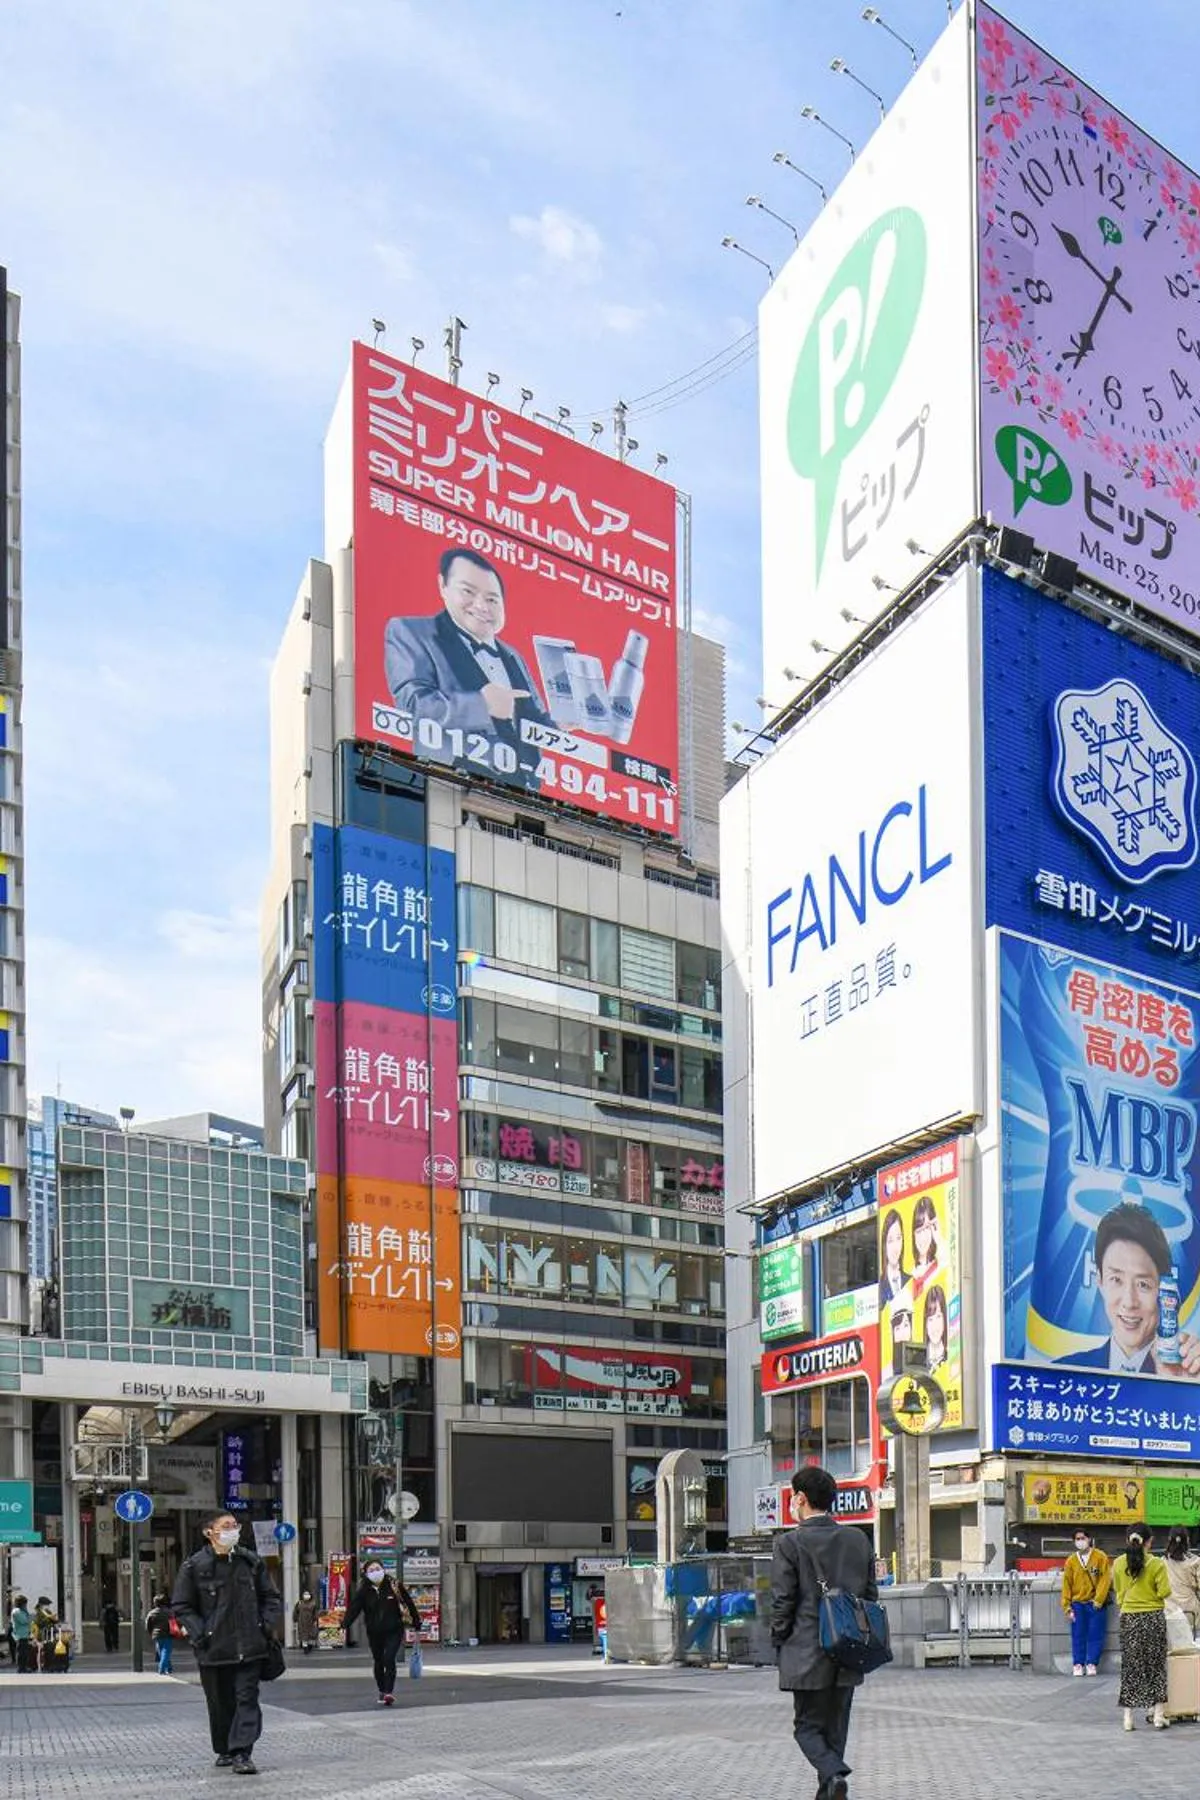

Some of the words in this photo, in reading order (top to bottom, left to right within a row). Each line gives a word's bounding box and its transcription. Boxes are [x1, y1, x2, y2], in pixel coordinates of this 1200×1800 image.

[1019, 158, 1054, 207] 10
[1055, 148, 1084, 187] 11
[1094, 164, 1125, 211] 12
[1011, 210, 1039, 246] 9
[1024, 277, 1053, 304] 8
[368, 358, 543, 456] スーパー
[1103, 375, 1122, 410] 6
[1142, 386, 1163, 422] 5
[1170, 368, 1193, 401] 4
[368, 401, 669, 552] ミリオンヘアー
[842, 403, 931, 562] ピップ
[368, 452, 475, 510] SUPER
[486, 505, 593, 566] MILLION
[602, 550, 670, 592] HAIR
[1084, 471, 1177, 560] ピップ
[1079, 532, 1129, 579] Mar.
[527, 726, 579, 752] ルアン
[342, 871, 432, 924] 龍角散
[767, 783, 953, 988] FANCL
[800, 942, 912, 1040] 正直品質。
[1068, 969, 1194, 1048] 骨密度を
[344, 1046, 435, 1095] 龍角散
[1082, 1023, 1180, 1088] 高める
[1066, 1076, 1196, 1184] MBP
[347, 1221, 437, 1265] 龍角散
[792, 1341, 858, 1375] LOTTERIA
[121, 1381, 174, 1398] EBISU
[176, 1384, 266, 1403] BASHI-SUJI
[1008, 1374, 1121, 1401] スキージャンプ
